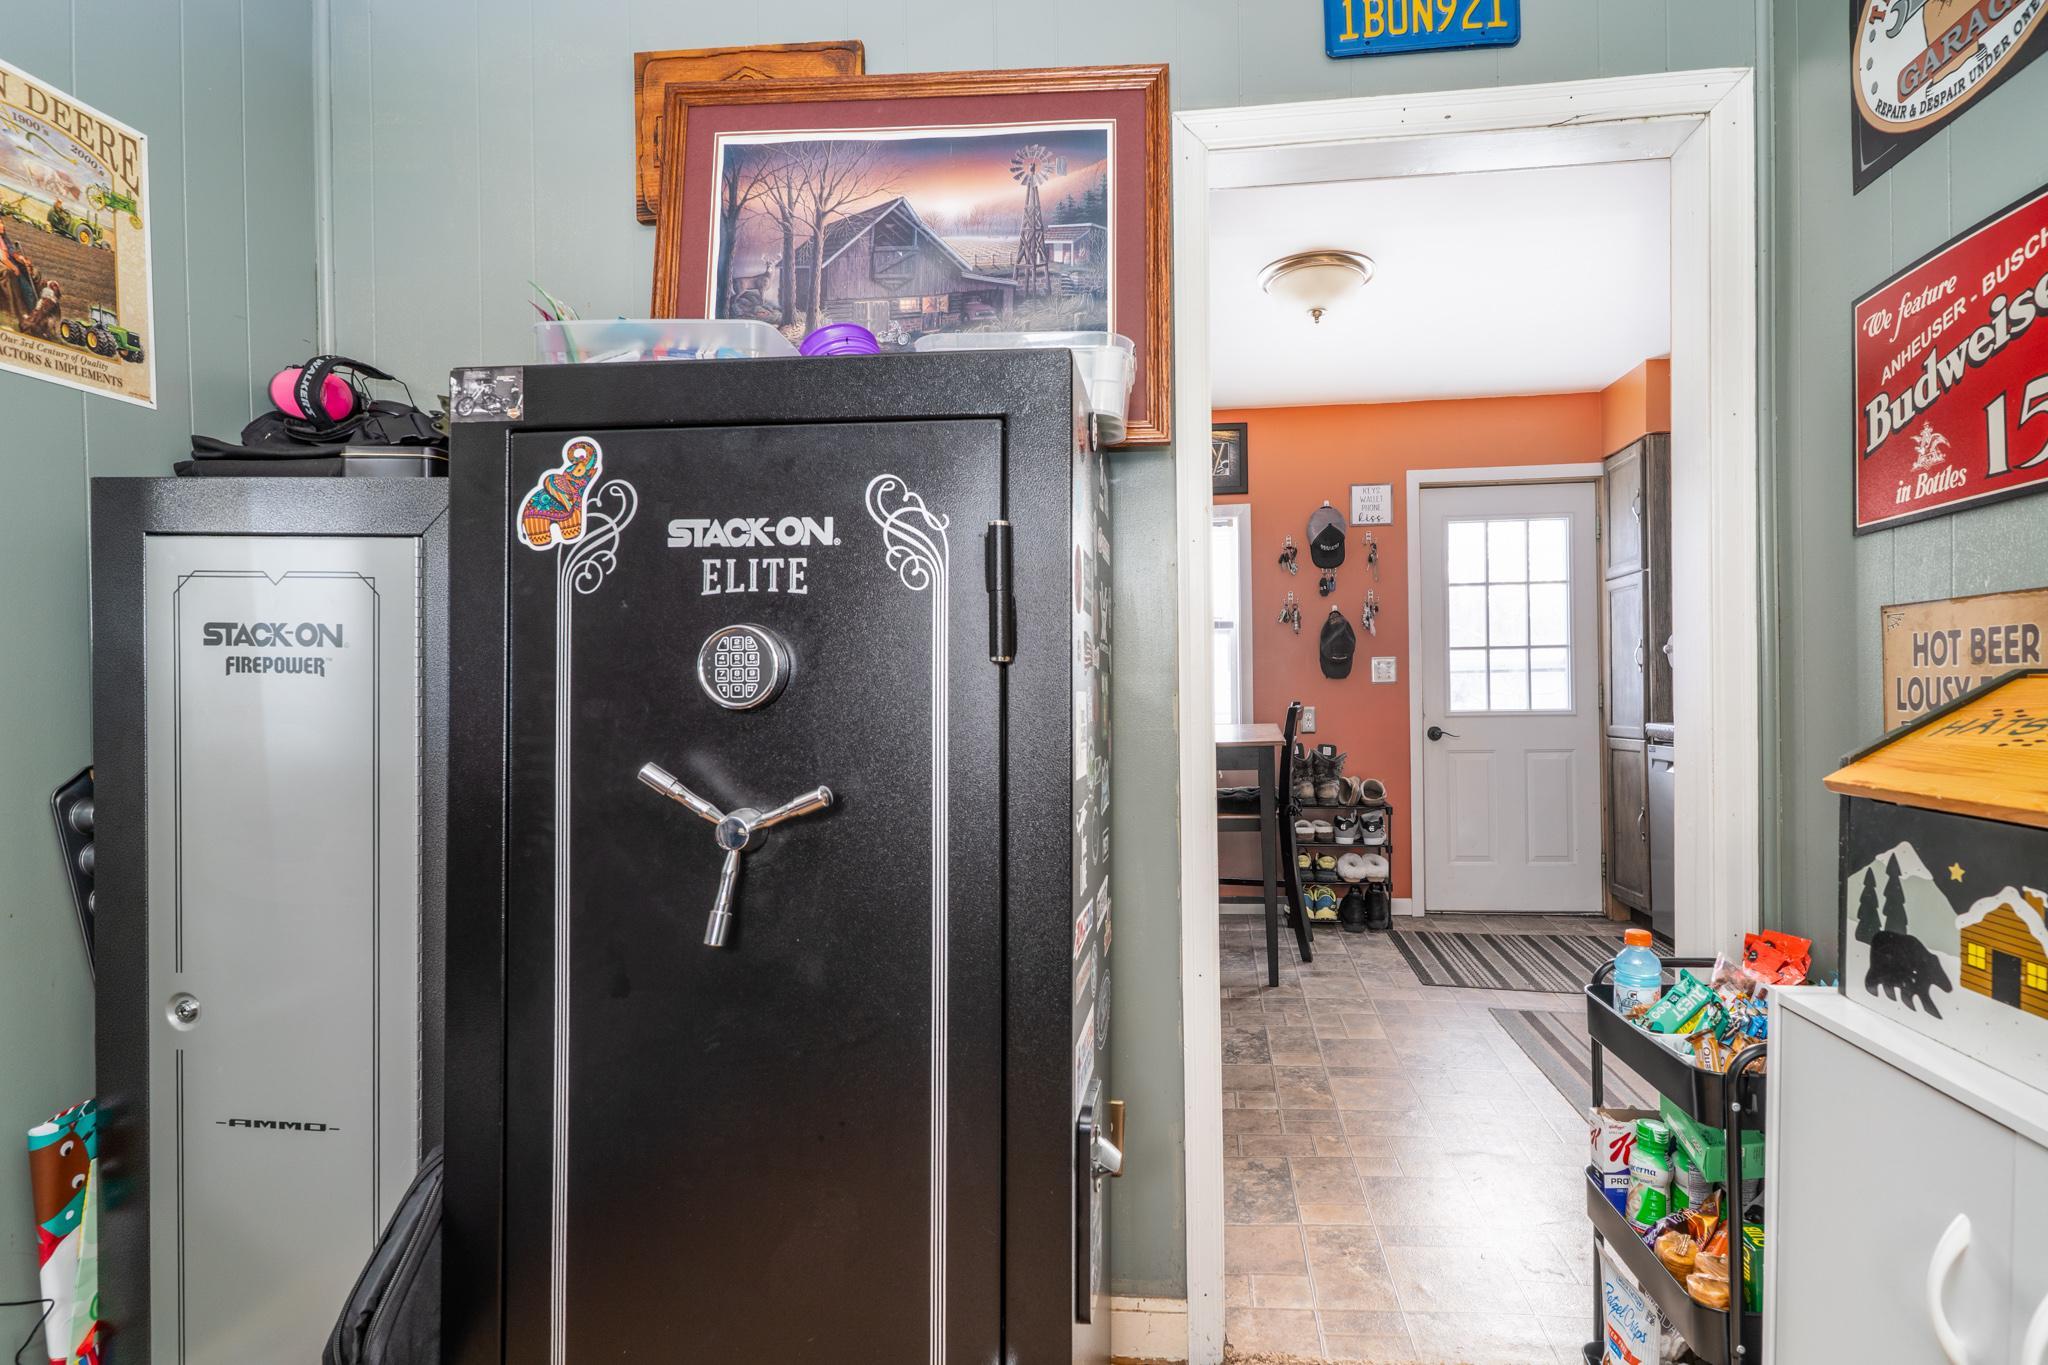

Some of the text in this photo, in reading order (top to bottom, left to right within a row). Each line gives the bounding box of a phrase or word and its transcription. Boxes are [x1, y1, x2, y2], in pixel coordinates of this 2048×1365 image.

[1875, 0, 2040, 119] REPAIR & DESPAIR UNDER ONE
[1900, 0, 2024, 96] GARAG
[24, 82, 140, 197] DEERE
[1863, 275, 1958, 343] We feature
[1, 332, 109, 372] Our 3rd Century of Quality
[1881, 296, 1967, 385] ANHEUSER
[55, 361, 123, 387] IMPLEMENTS
[1896, 465, 1967, 504] in Bottles
[701, 558, 808, 596] ELITE
[1912, 623, 2040, 667] HOT BEER
[225, 656, 326, 677] FIREPOWER
[228, 1118, 327, 1132] AMMO
